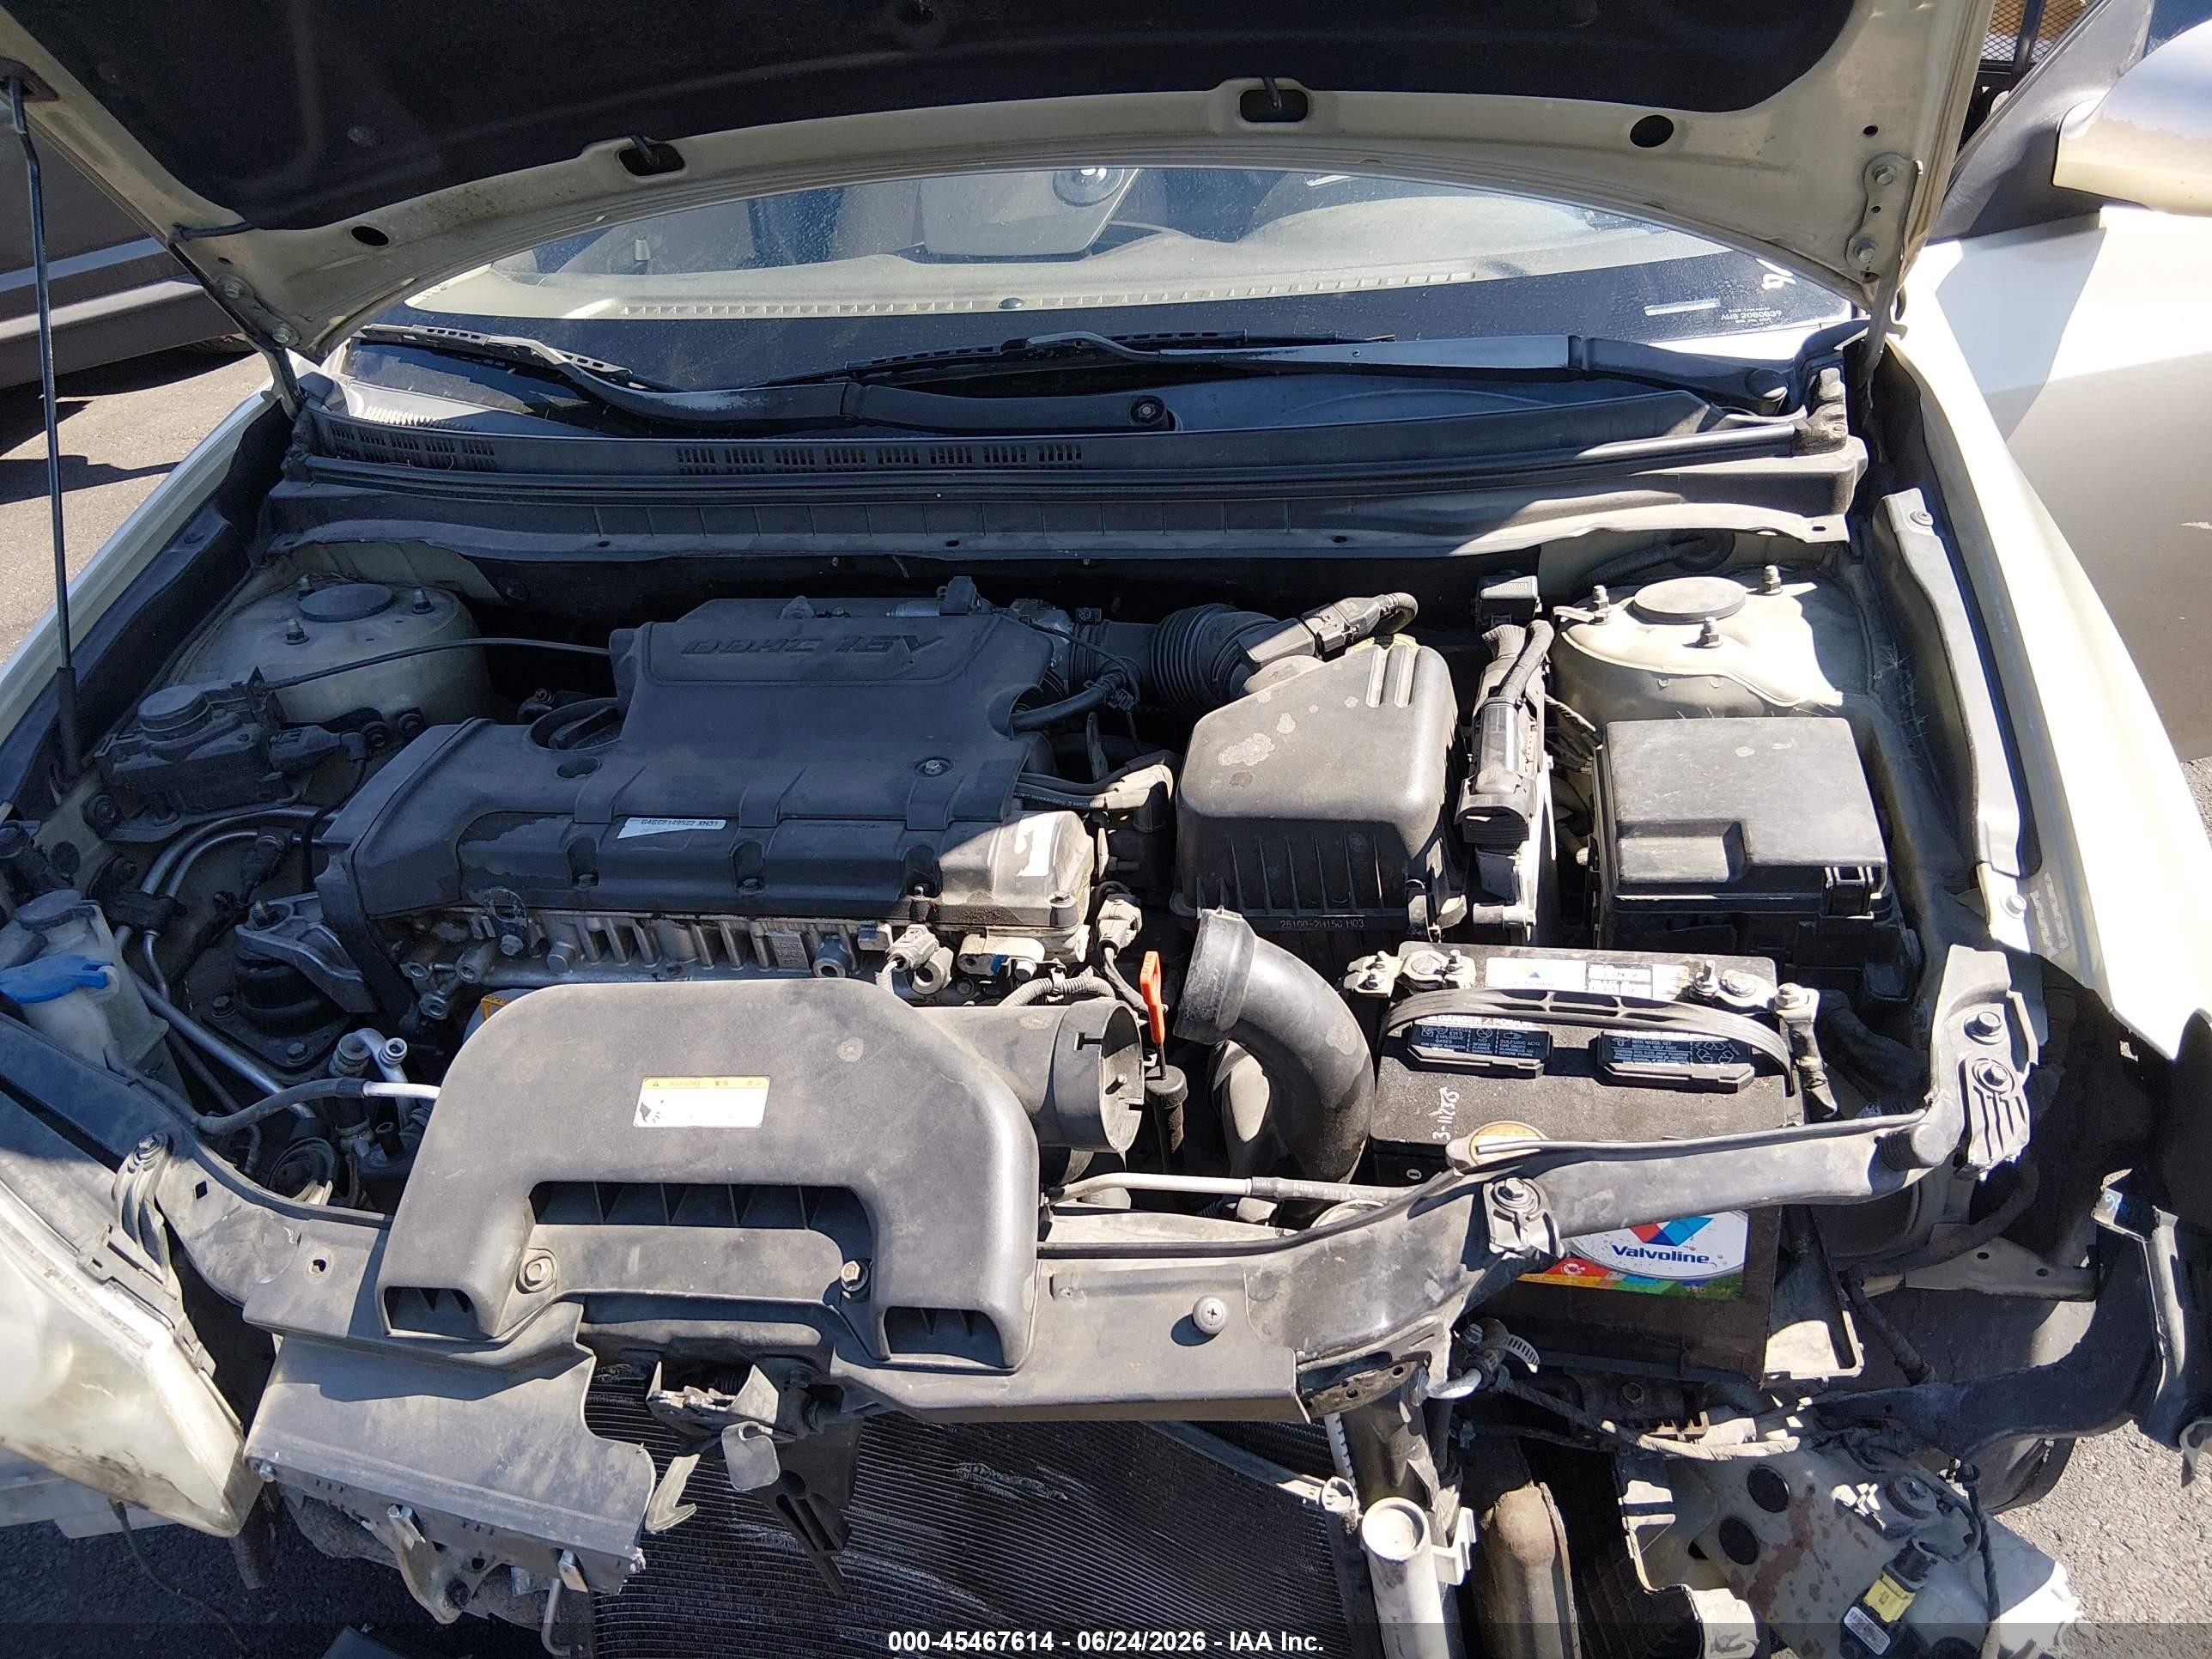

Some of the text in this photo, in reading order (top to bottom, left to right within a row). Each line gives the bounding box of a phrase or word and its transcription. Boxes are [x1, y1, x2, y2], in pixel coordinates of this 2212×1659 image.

[835, 634, 945, 655] 16V
[1437, 1015, 1482, 1025] DANGER
[1611, 1244, 1710, 1264] Valvoline
